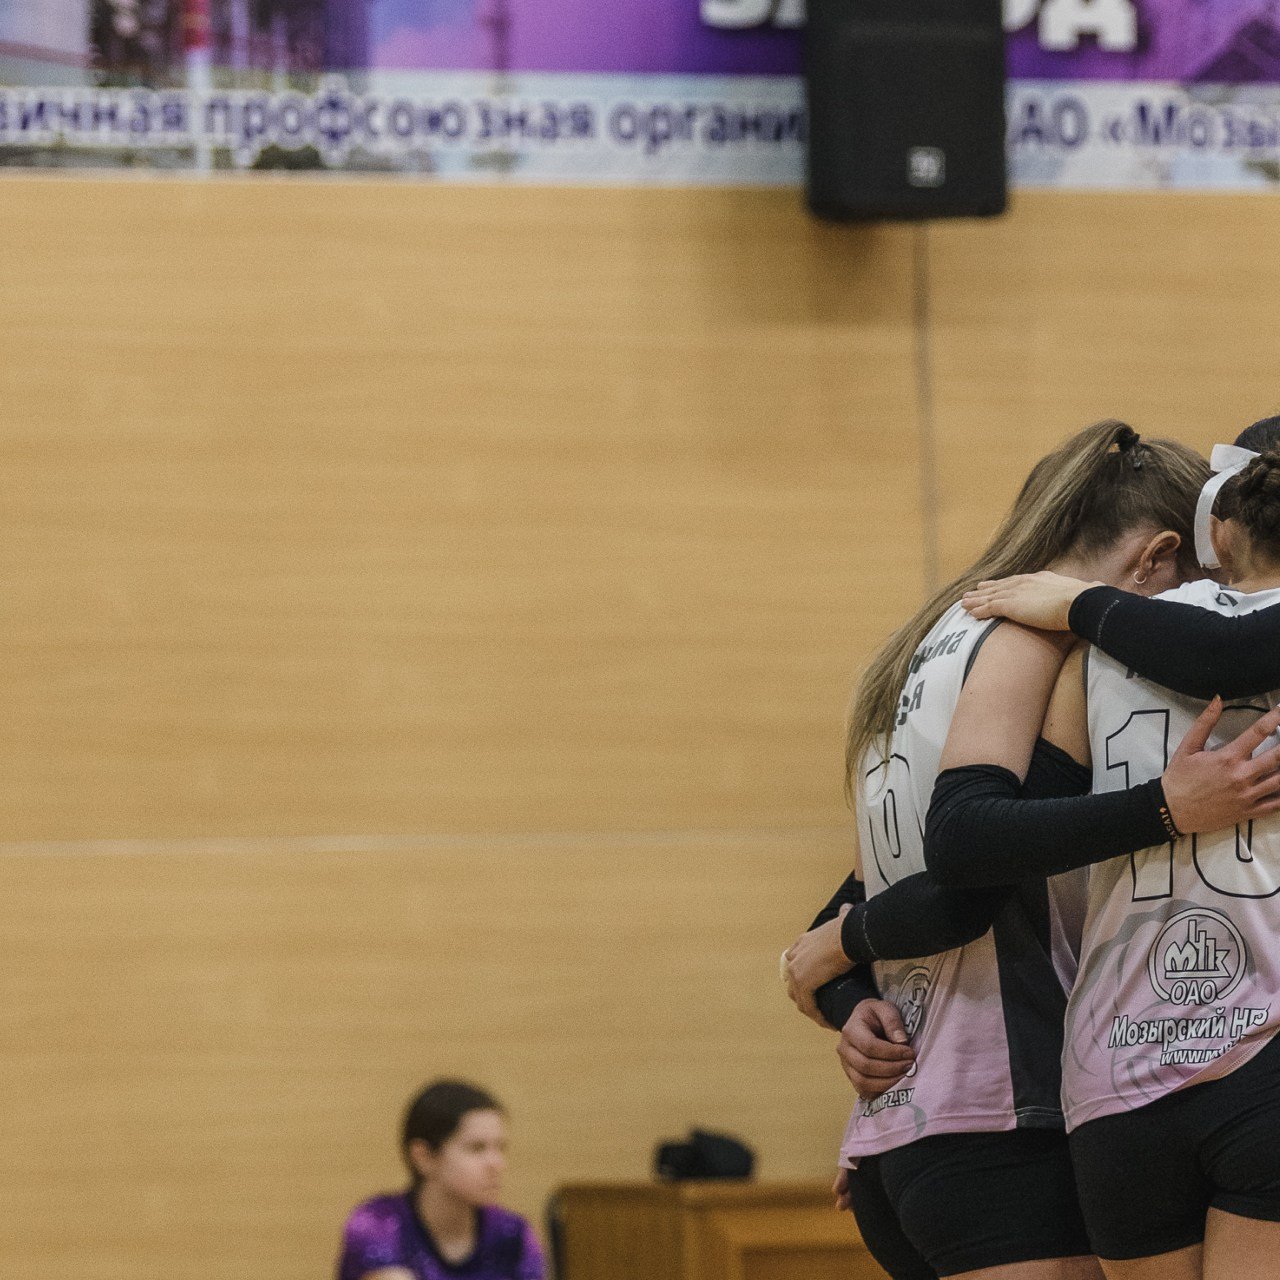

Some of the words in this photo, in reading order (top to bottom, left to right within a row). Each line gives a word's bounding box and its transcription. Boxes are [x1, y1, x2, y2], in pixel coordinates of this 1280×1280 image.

[0, 97, 191, 137] ичная
[204, 90, 596, 150] профсоюзная
[608, 102, 803, 156] органи
[1004, 92, 1089, 147] АО
[1170, 979, 1218, 1006] ОАО
[1108, 1007, 1226, 1053] Мозырский
